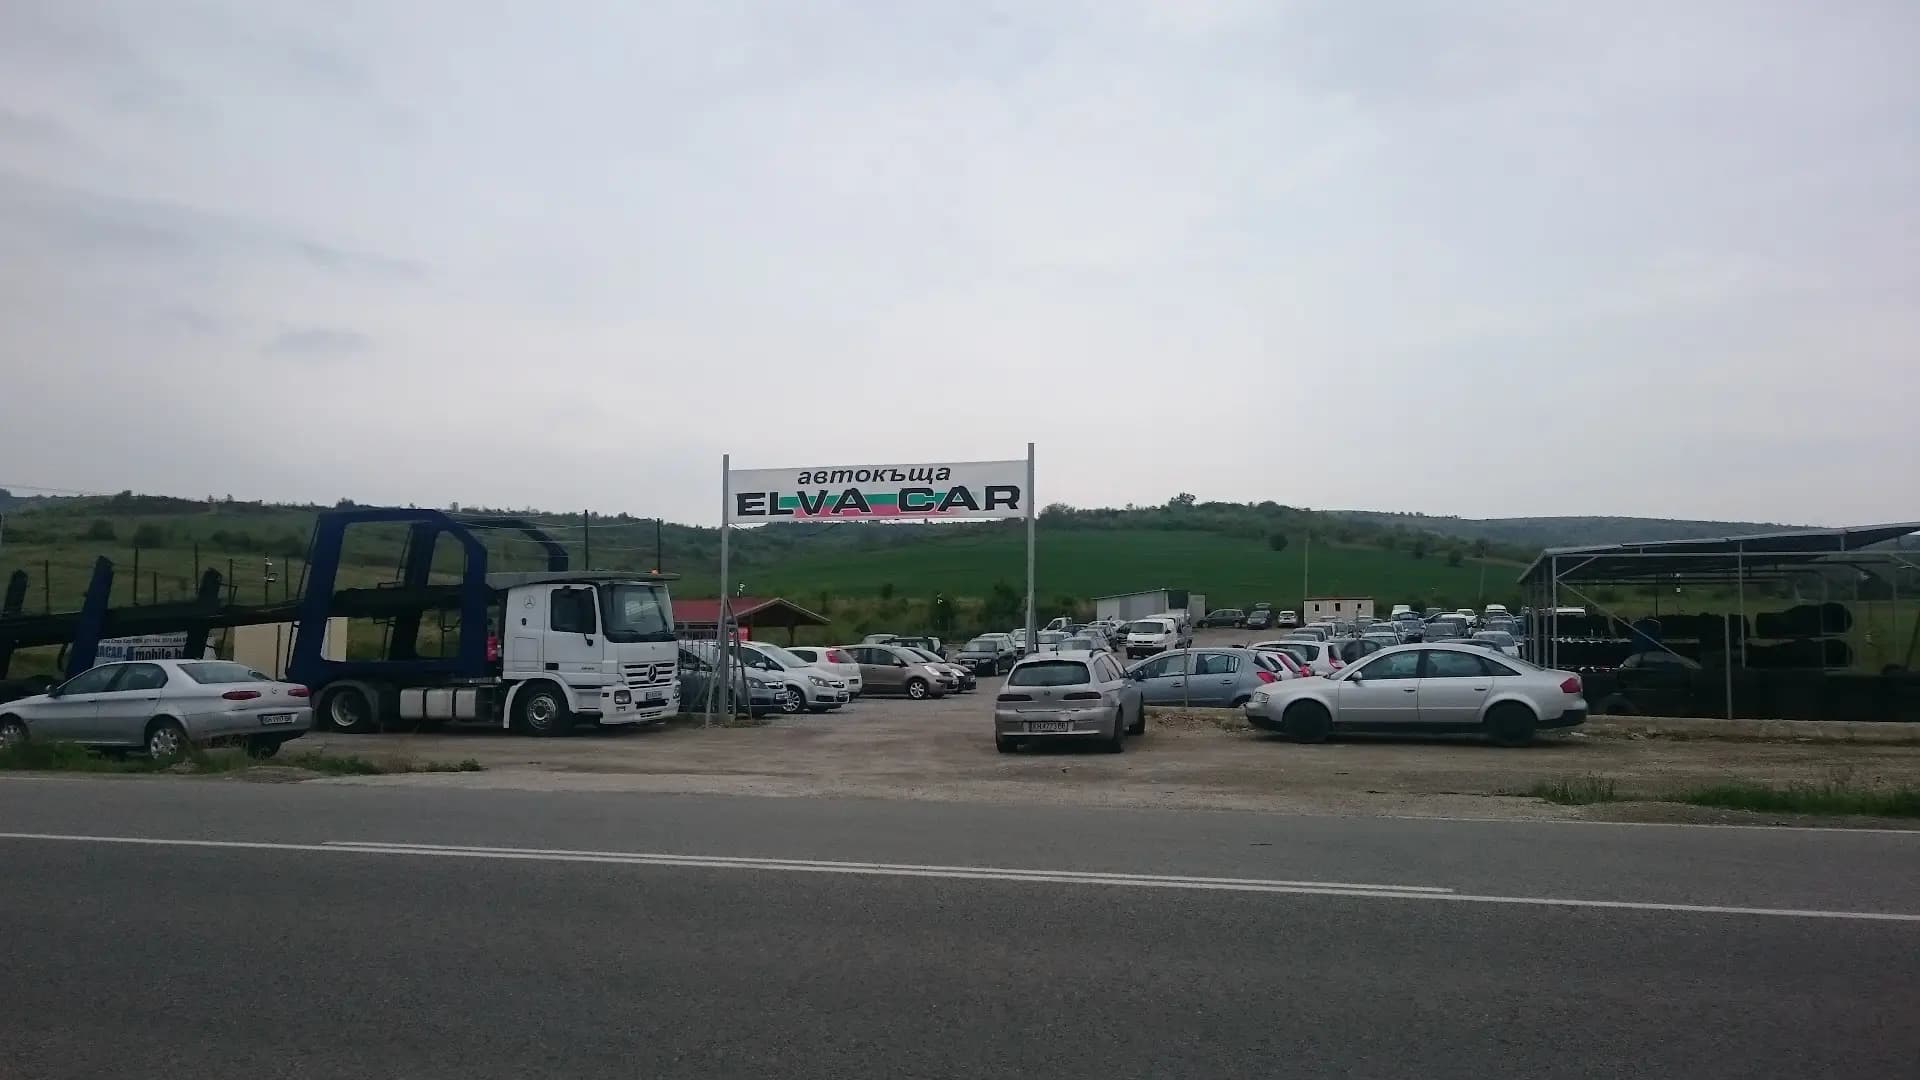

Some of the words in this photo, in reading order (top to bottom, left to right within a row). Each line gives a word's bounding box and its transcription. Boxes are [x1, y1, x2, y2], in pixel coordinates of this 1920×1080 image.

[797, 466, 951, 485] автокъща
[736, 487, 872, 516] ELVA
[897, 485, 1021, 512] CAR
